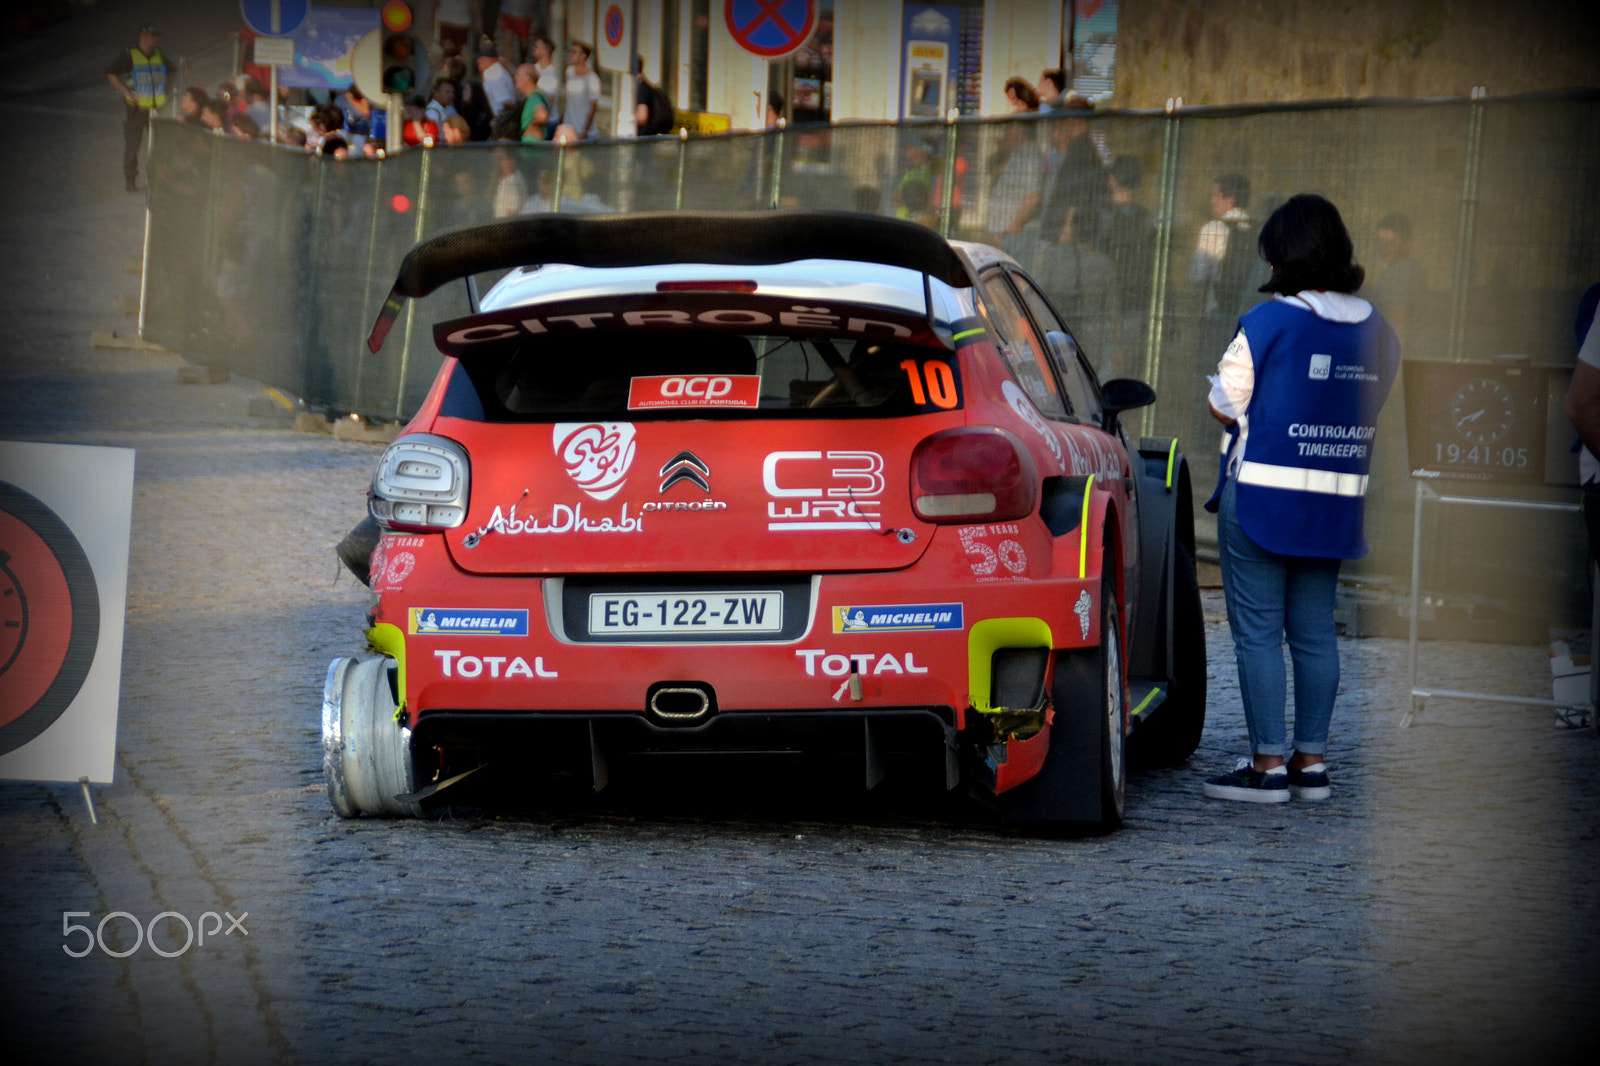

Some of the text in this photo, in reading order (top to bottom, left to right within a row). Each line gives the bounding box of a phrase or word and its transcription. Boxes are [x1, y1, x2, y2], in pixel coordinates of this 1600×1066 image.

[446, 305, 912, 346] CITROËN
[660, 376, 733, 400] acp
[900, 358, 959, 409] 10
[1287, 423, 1376, 439] CONTROLADOR
[1297, 442, 1368, 458] TIMEKEEPER
[1435, 443, 1528, 467] 19:41:05
[762, 450, 886, 498] C3
[642, 499, 728, 511] CITROËN
[767, 500, 881, 518] WRC
[989, 524, 1019, 534] YEARS
[397, 537, 425, 547] YEARS
[958, 525, 1027, 575] 50
[440, 616, 518, 629] MICHELIN
[603, 597, 768, 627] EG-122-ZW
[869, 611, 953, 625] MICHELIN
[433, 649, 559, 678] TOTAL
[795, 649, 929, 677] TOTAL
